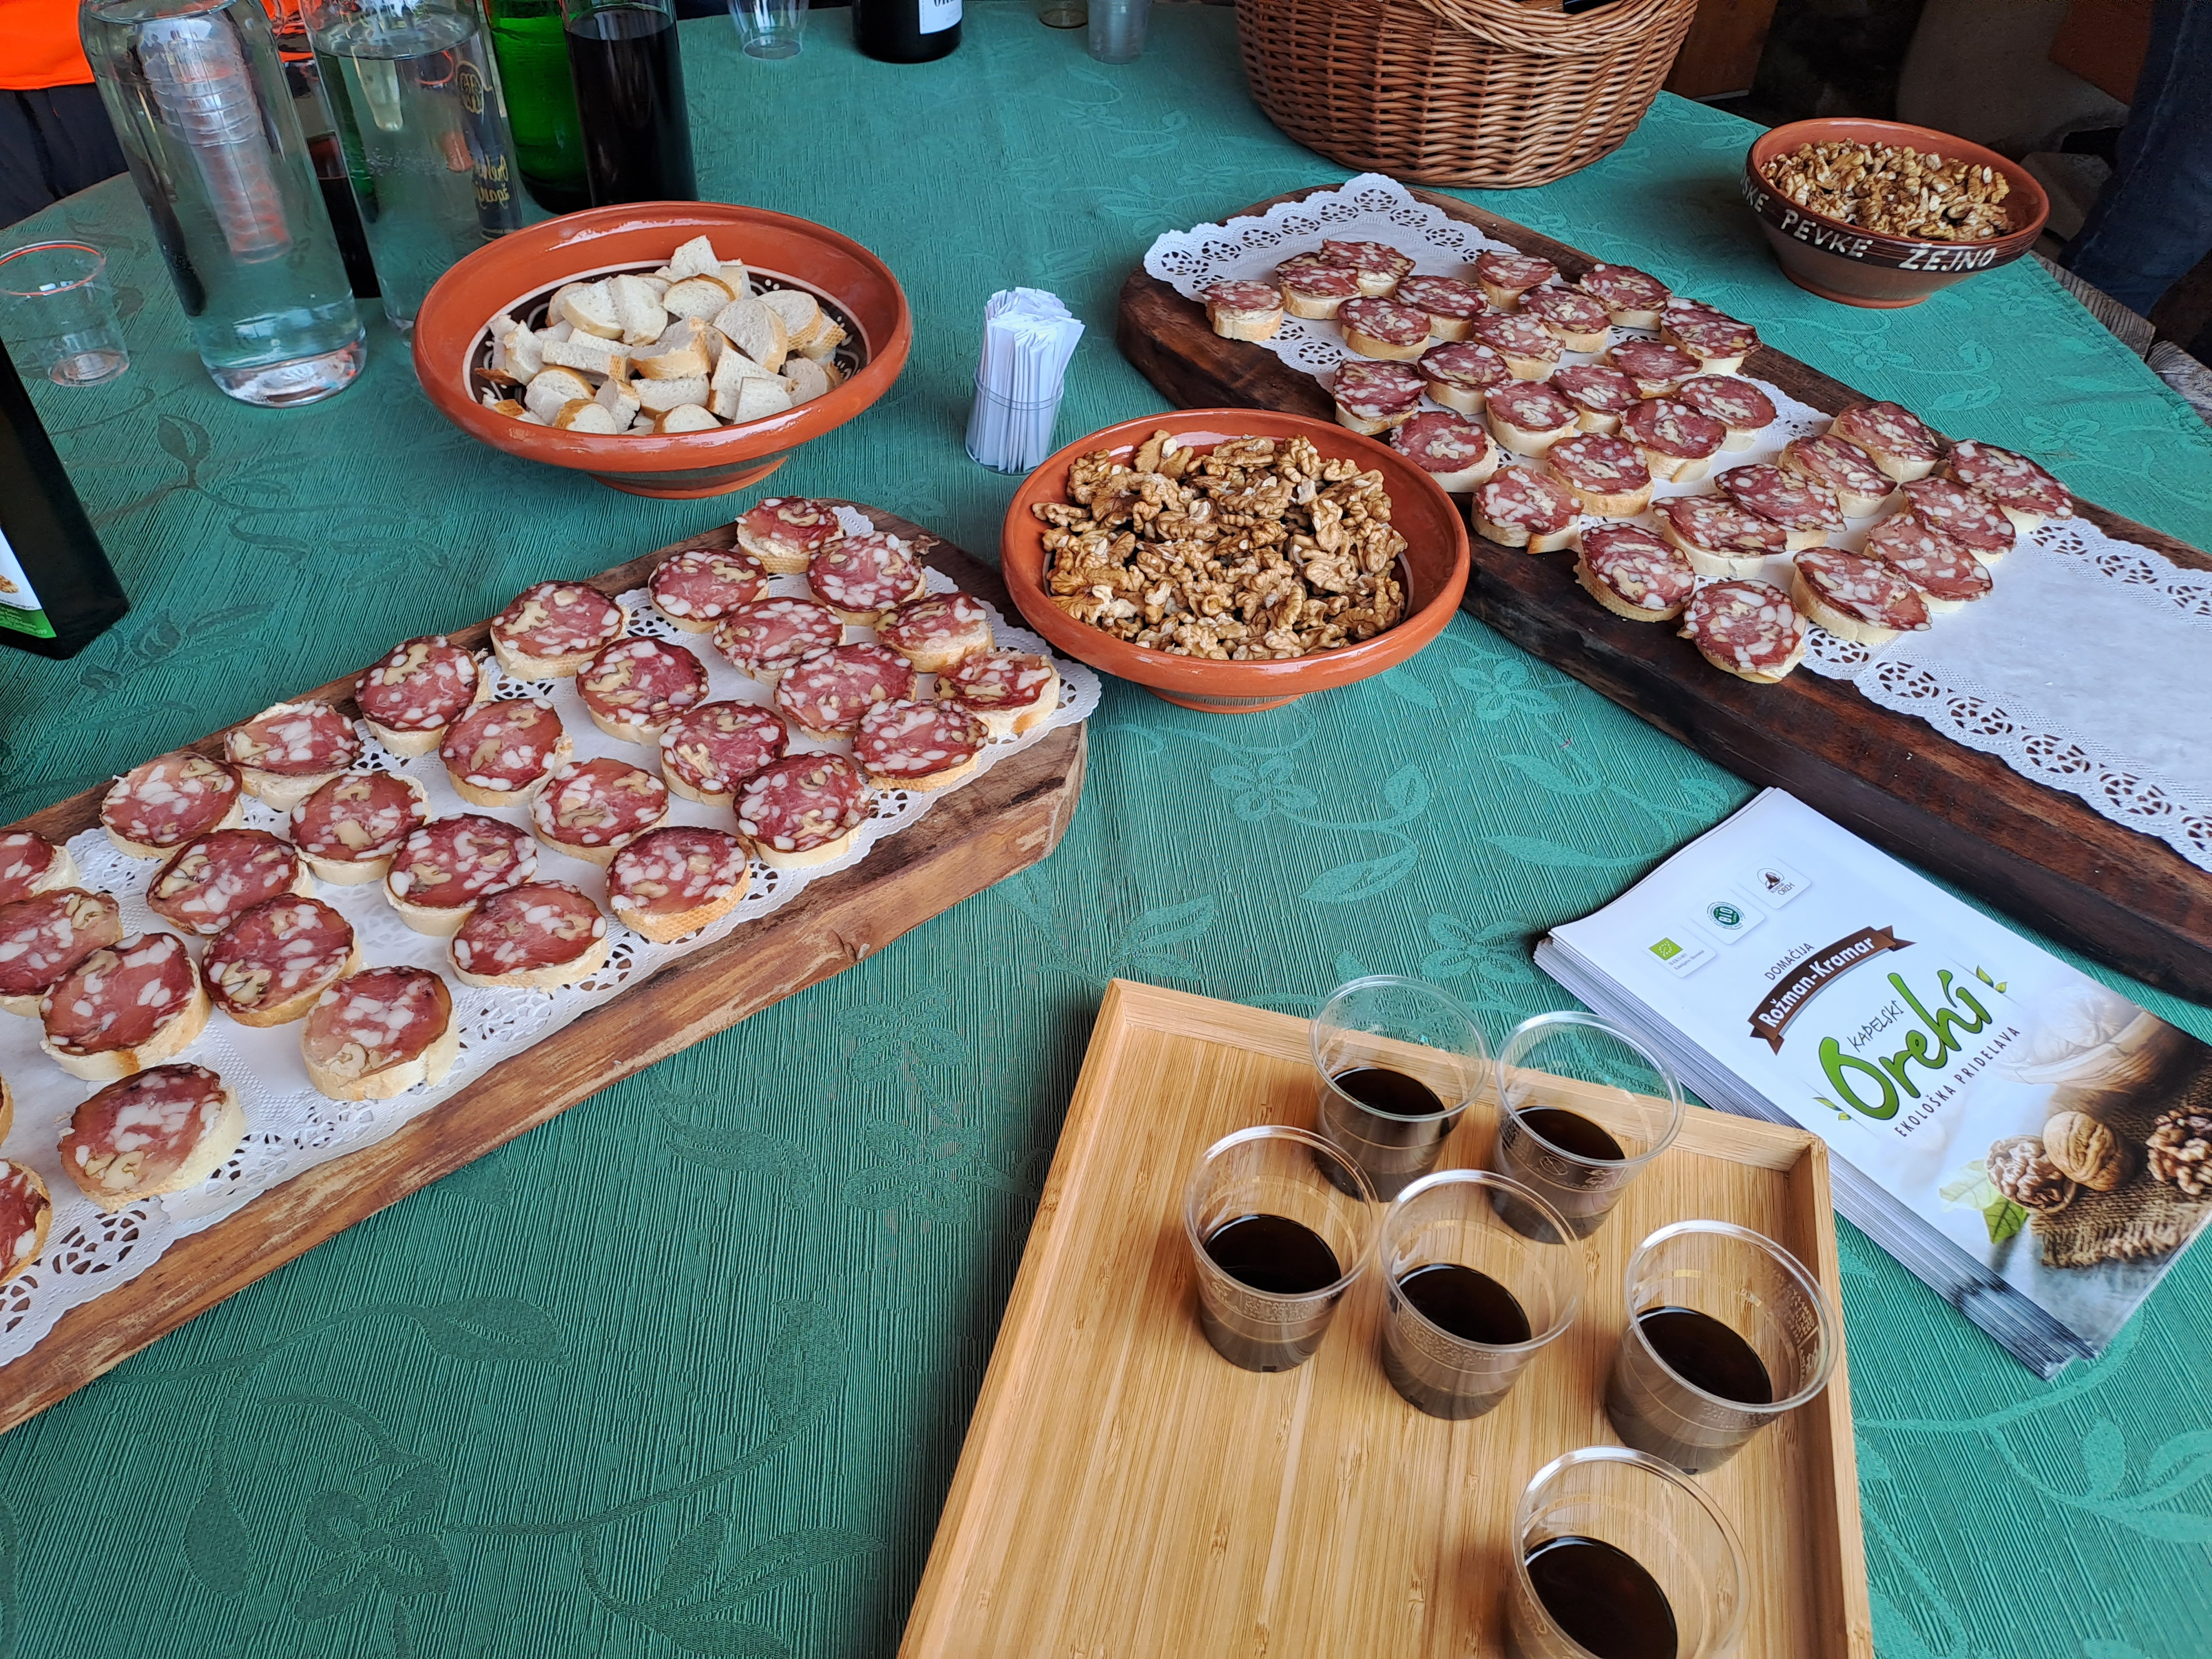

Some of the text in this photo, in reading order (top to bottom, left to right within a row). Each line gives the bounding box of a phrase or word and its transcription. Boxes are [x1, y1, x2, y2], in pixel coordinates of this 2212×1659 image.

[1781, 208, 1874, 258] PEVKE
[1898, 243, 1997, 272] ŽEJNO
[1718, 907, 1733, 923] BIO
[1777, 882, 1796, 895] OREH
[1758, 937, 1875, 1028] Rožman-Kramar
[1764, 943, 1815, 980] DOMAČIJA
[1846, 1000, 1905, 1053] KAPELSKI
[1894, 1026, 2021, 1138] EKOLOŠKA PRIDELAVA
